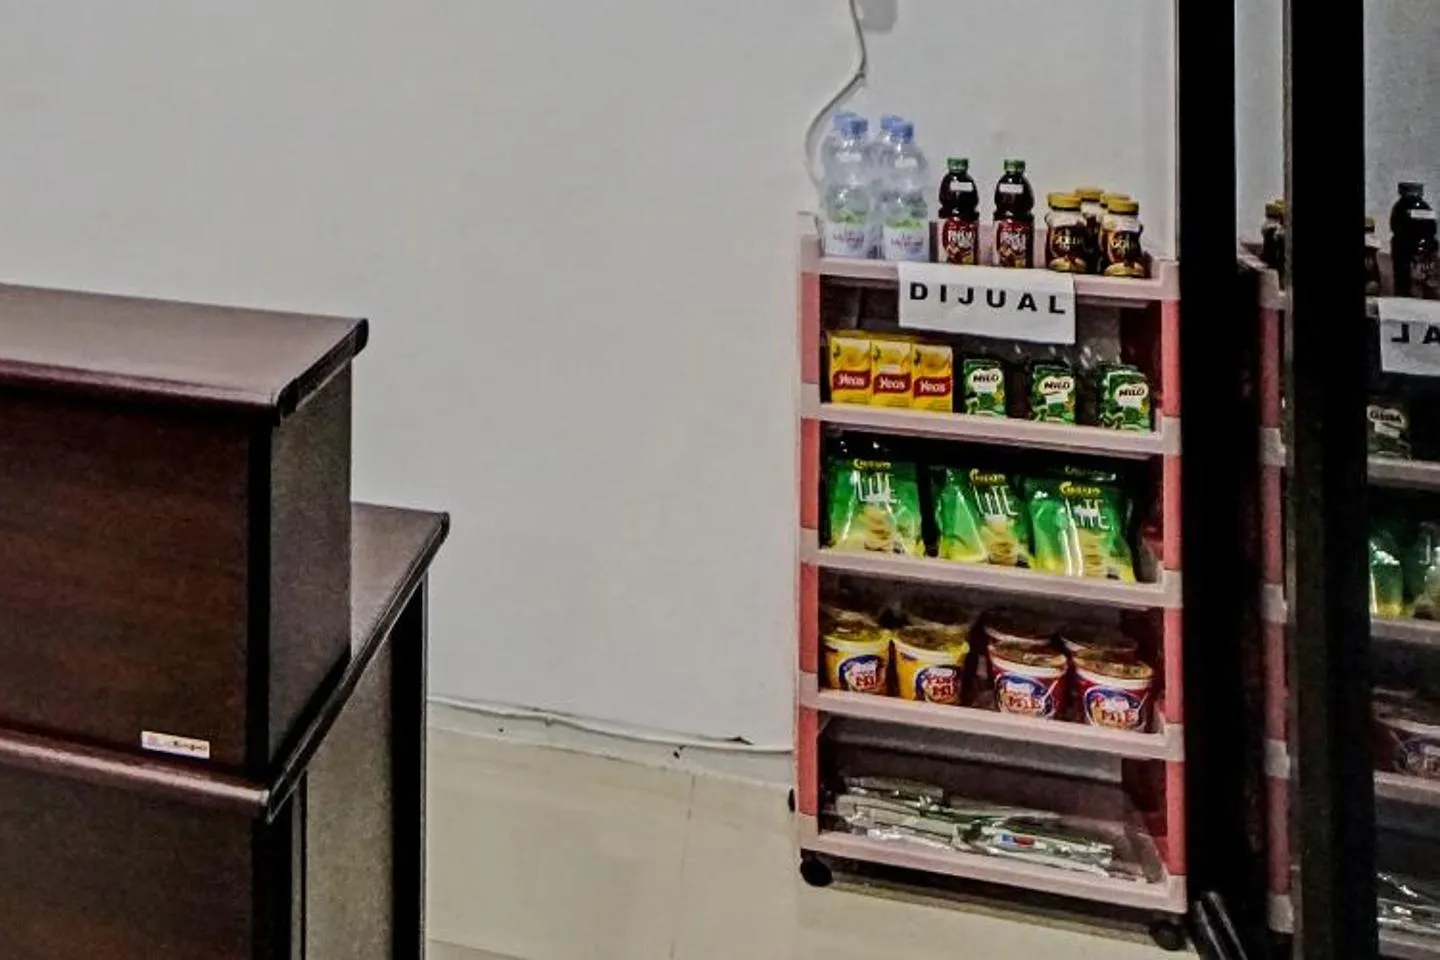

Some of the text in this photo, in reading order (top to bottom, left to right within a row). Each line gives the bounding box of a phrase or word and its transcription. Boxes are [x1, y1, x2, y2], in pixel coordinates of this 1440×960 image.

[909, 281, 1066, 315] DIJUAL
[972, 372, 999, 384] MILO
[1044, 381, 1071, 390] MILO
[1118, 388, 1145, 398] MILO
